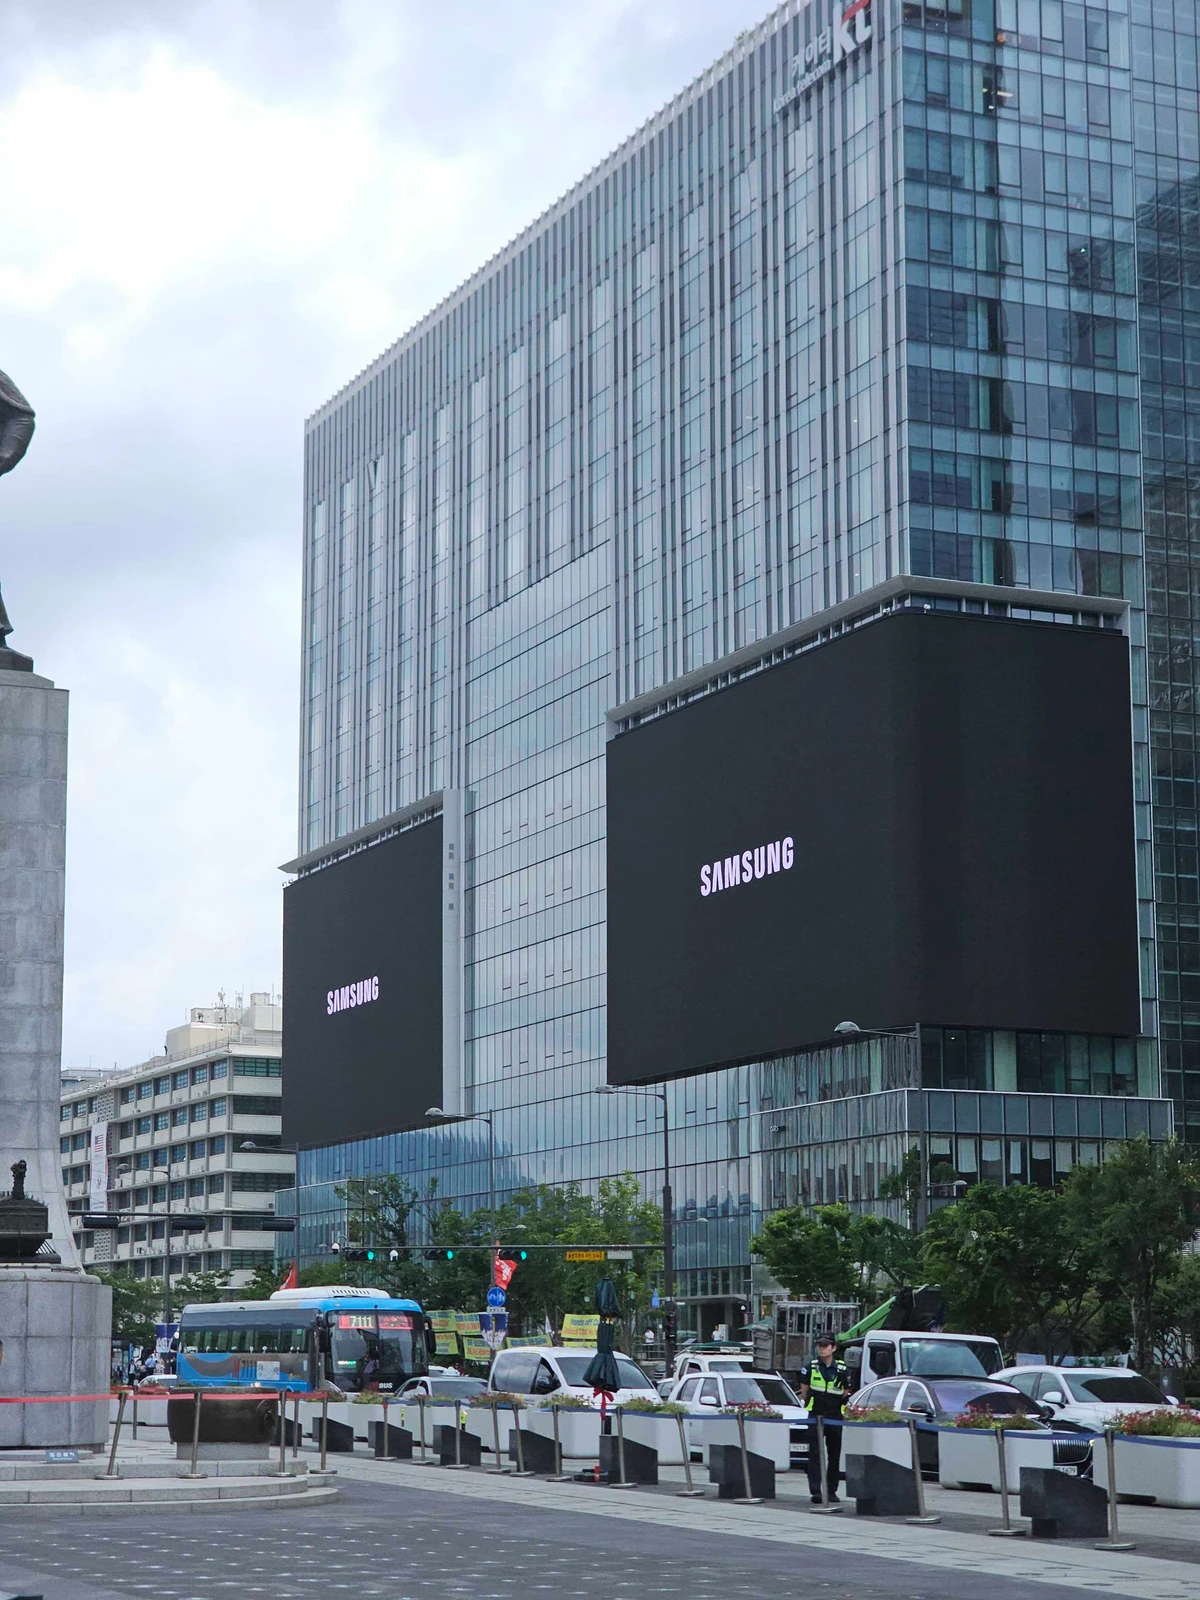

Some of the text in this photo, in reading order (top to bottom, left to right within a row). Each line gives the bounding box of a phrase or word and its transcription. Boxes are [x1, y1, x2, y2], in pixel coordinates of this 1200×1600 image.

[792, 26, 831, 78] 케이티
[833, 0, 872, 66] kt
[700, 836, 794, 897] SAMSUNG
[327, 975, 379, 1015] SAMSUNG
[350, 1315, 372, 1328] 7111
